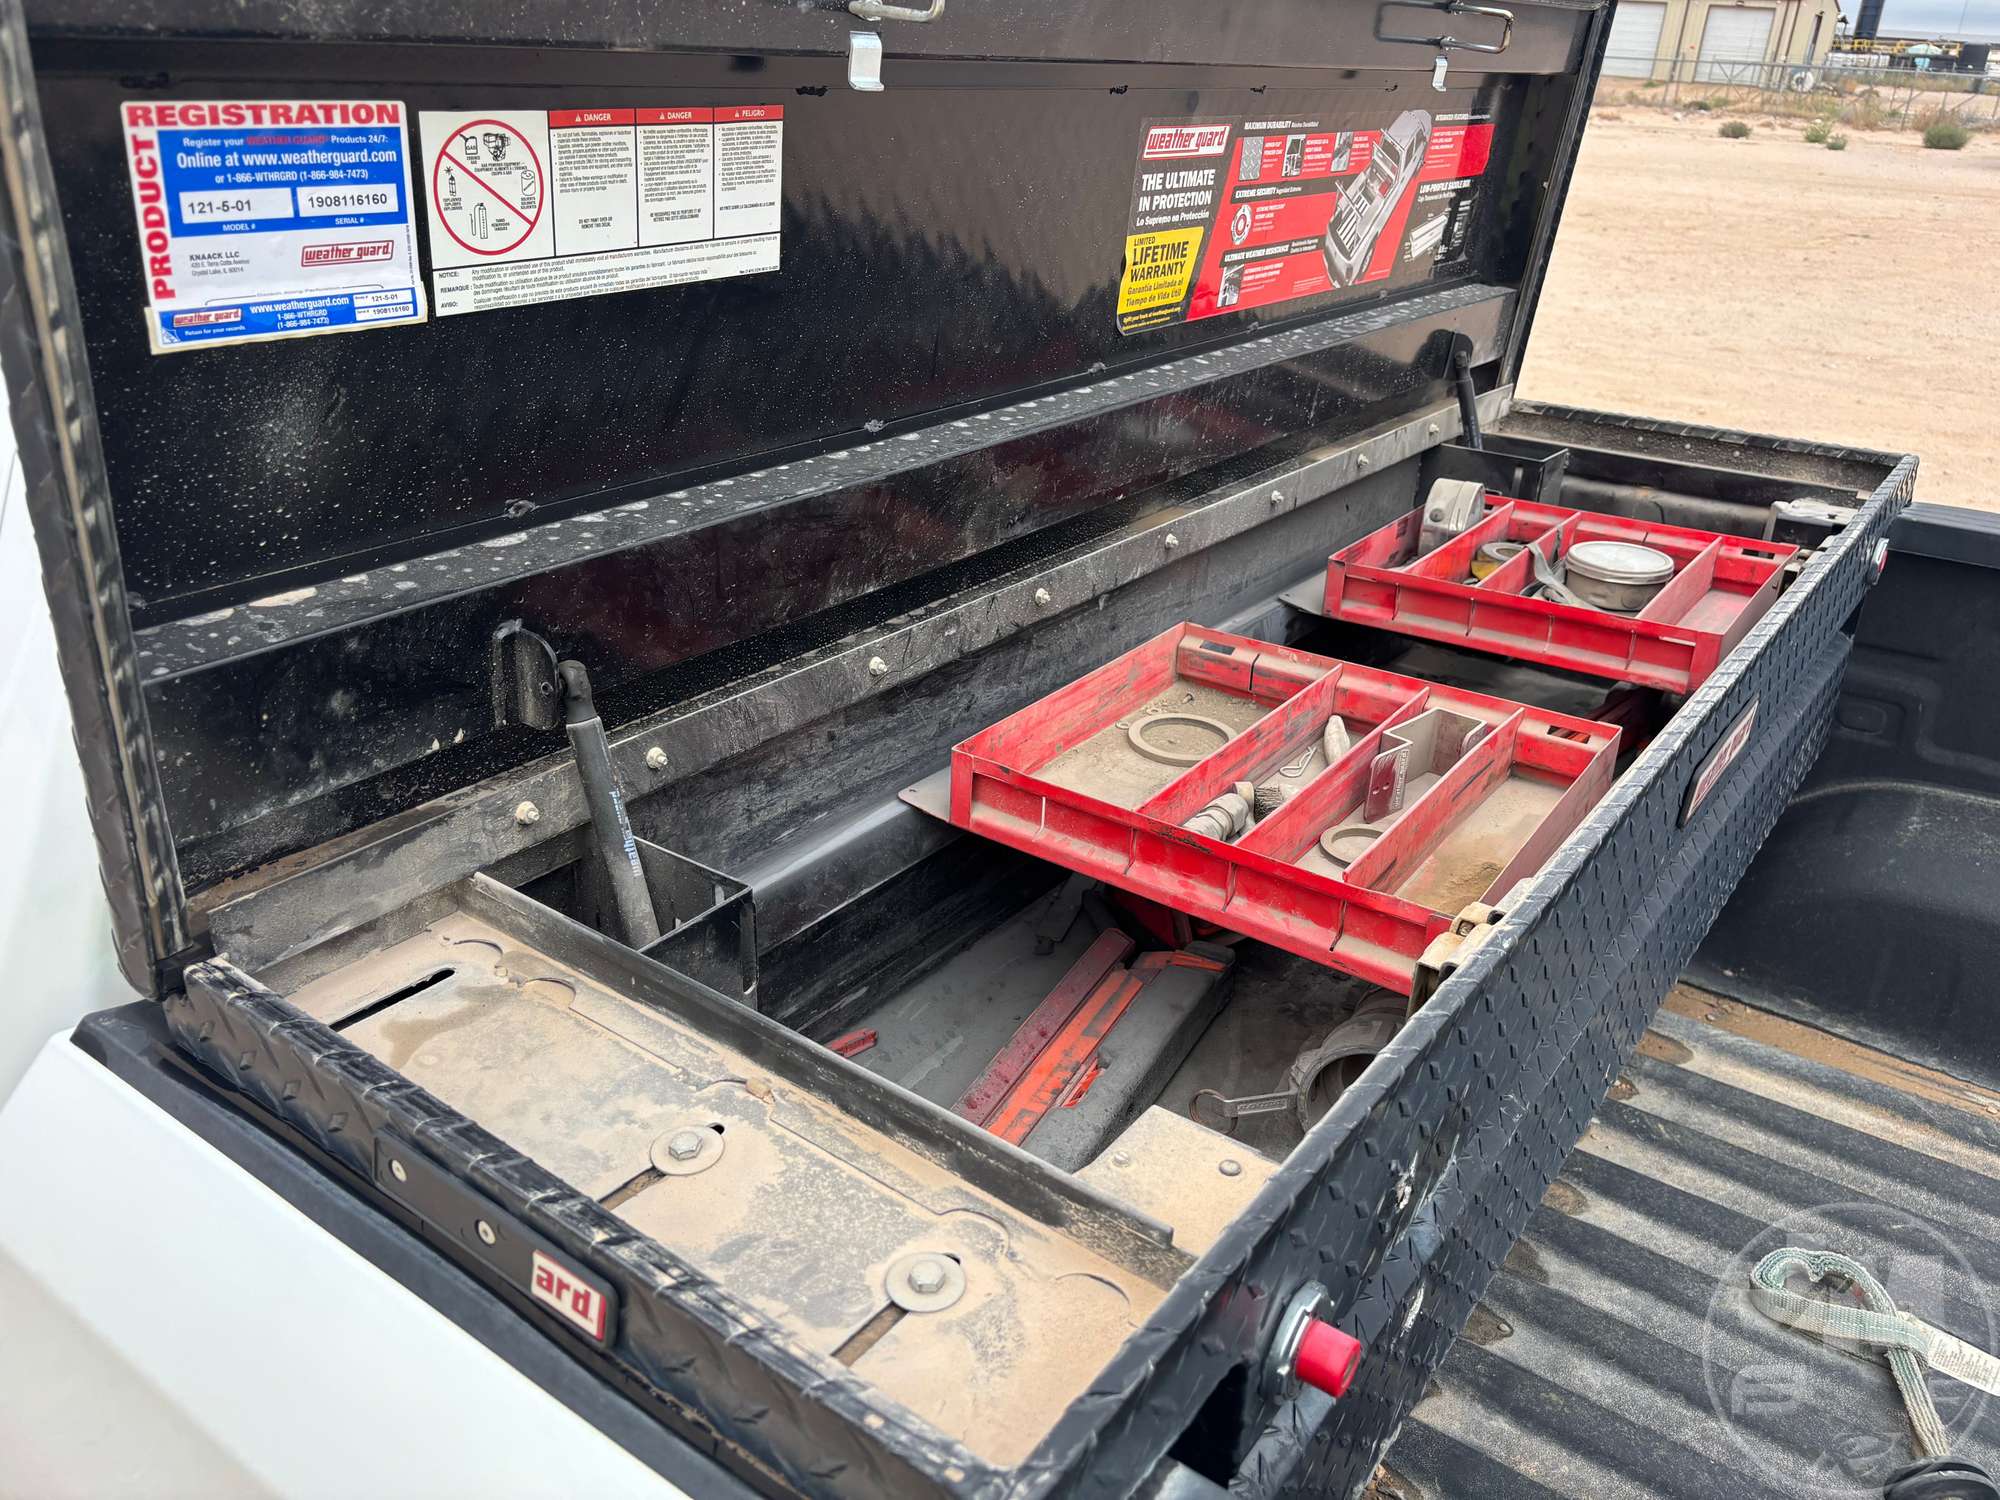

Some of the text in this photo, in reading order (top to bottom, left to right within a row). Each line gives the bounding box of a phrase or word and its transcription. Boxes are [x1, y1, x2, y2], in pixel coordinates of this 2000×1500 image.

[126, 103, 400, 127] REGISTRATION
[584, 113, 612, 121] DANGER
[667, 112, 692, 120] DANGER
[1267, 120, 1292, 129] DURABILITY
[183, 138, 221, 148] Register
[224, 139, 244, 148] your
[331, 136, 366, 144] Products
[368, 136, 388, 144] 24/7:
[1148, 126, 1226, 150] weather guard
[177, 149, 396, 168] Online at www.weatherguard.com
[216, 169, 368, 184] or 1-866-WTHRGRD (1-866-984-7473)
[1142, 169, 1216, 191] THE ULTIMATE
[1256, 187, 1276, 196] SECURITY
[188, 200, 252, 214] 121-5-01
[308, 194, 388, 208] 1908116160
[1139, 190, 1212, 212] IN PROTECTION
[131, 135, 176, 300] PRODUCT
[1136, 218, 1144, 227] Lo
[1145, 216, 1171, 226] Supremo
[1180, 209, 1210, 221] Protección
[223, 224, 248, 232] MODEL
[1134, 236, 1156, 246] LIMITED
[190, 252, 222, 260] KNAACK
[304, 242, 390, 262] weather guard
[1132, 240, 1189, 266] LIFETIME
[438, 271, 459, 279] NOTICE:
[1130, 260, 1186, 282] WARRANTY
[1128, 283, 1153, 295] Garantía
[1154, 280, 1177, 289] Limitada
[250, 296, 349, 314] www.weatherguard.com
[371, 294, 398, 302] 121-5-01
[1126, 297, 1148, 306] Tiempo
[1158, 292, 1170, 300] Vida
[277, 309, 328, 320] 1-866-WTHRGRD
[373, 305, 410, 315] 1908116160
[174, 311, 212, 326] weather
[536, 1261, 591, 1321] ard
